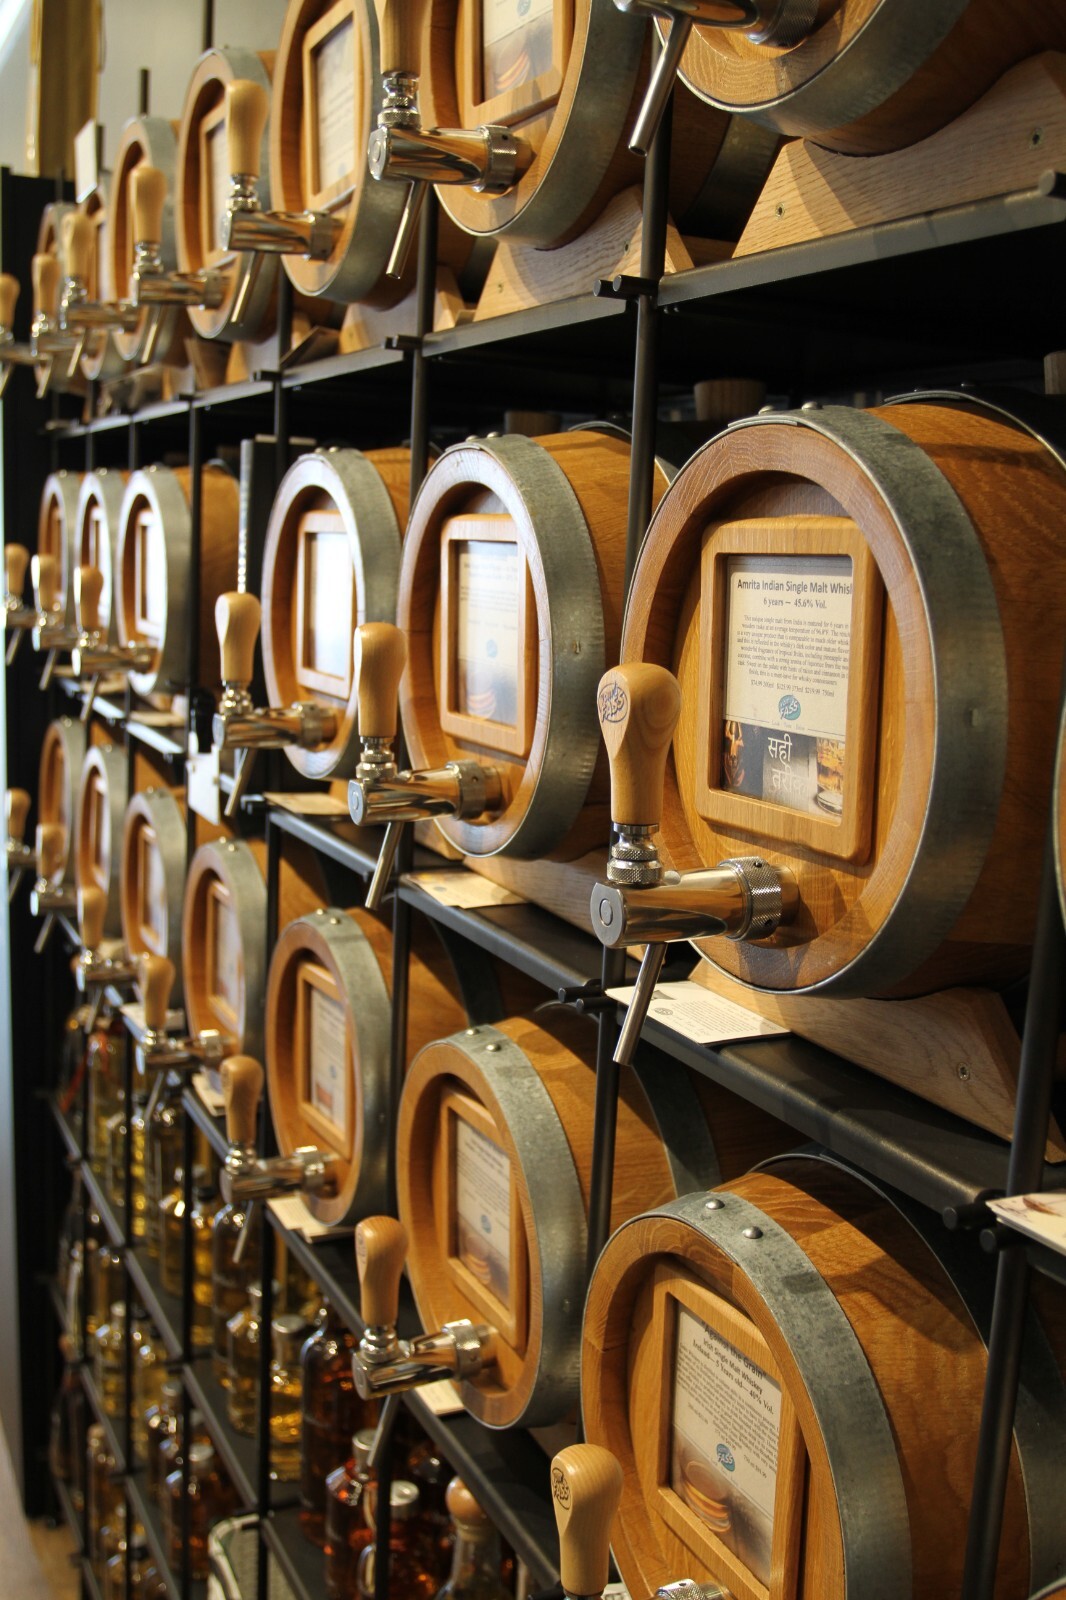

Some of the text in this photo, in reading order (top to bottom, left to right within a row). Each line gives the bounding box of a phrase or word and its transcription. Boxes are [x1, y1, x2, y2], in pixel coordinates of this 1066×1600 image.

[738, 579, 760, 590] Amrita
[762, 580, 784, 590] Indian
[786, 581, 808, 594] Single
[810, 582, 828, 594] Malt
[768, 600, 784, 608] years
[794, 598, 814, 608] 45.6%
[815, 600, 827, 609] Vol.
[768, 733, 792, 766] सही
[704, 1338, 714, 1352] Irish
[714, 1347, 728, 1365] Single
[742, 1370, 762, 1395] Whiskey
[720, 1363, 734, 1380] Years
[764, 1400, 774, 1416] Vol.
